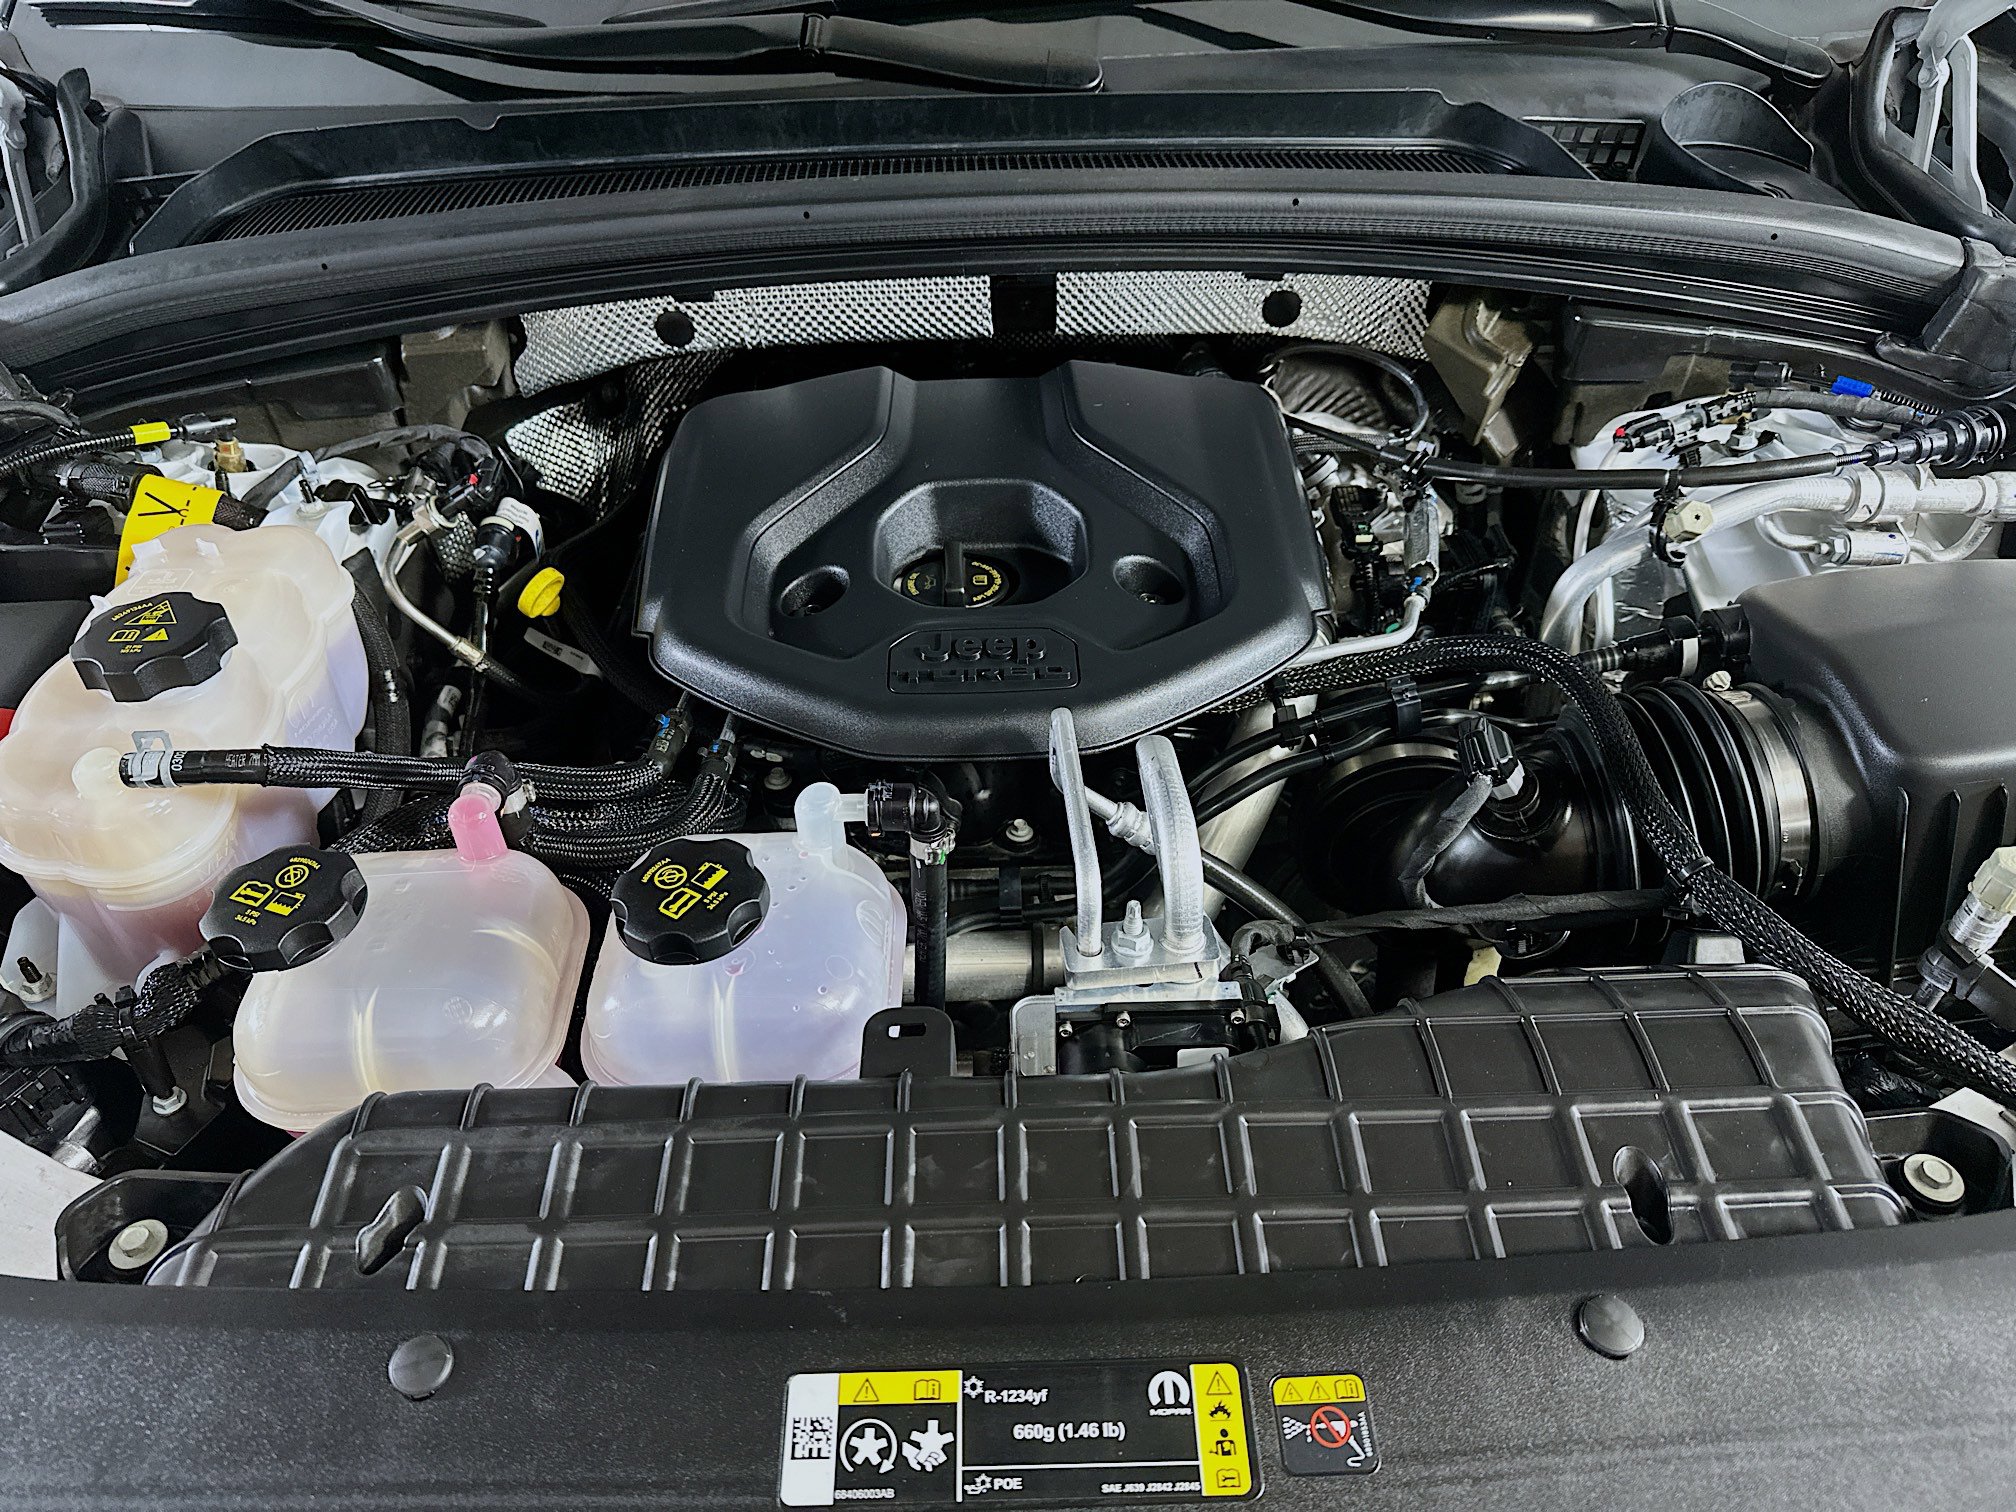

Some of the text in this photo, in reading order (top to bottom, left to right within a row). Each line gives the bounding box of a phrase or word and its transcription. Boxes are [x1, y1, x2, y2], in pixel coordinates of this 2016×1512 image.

[918, 631, 1046, 665] Jeep
[224, 752, 247, 769] HEATER
[984, 1389, 1049, 1406] R-1234yf
[1149, 1407, 1193, 1417] MOPAR
[1012, 1421, 1126, 1443] 660g (1.46 lb)
[993, 1477, 1022, 1491] POE
[1101, 1483, 1123, 1494] SAE
